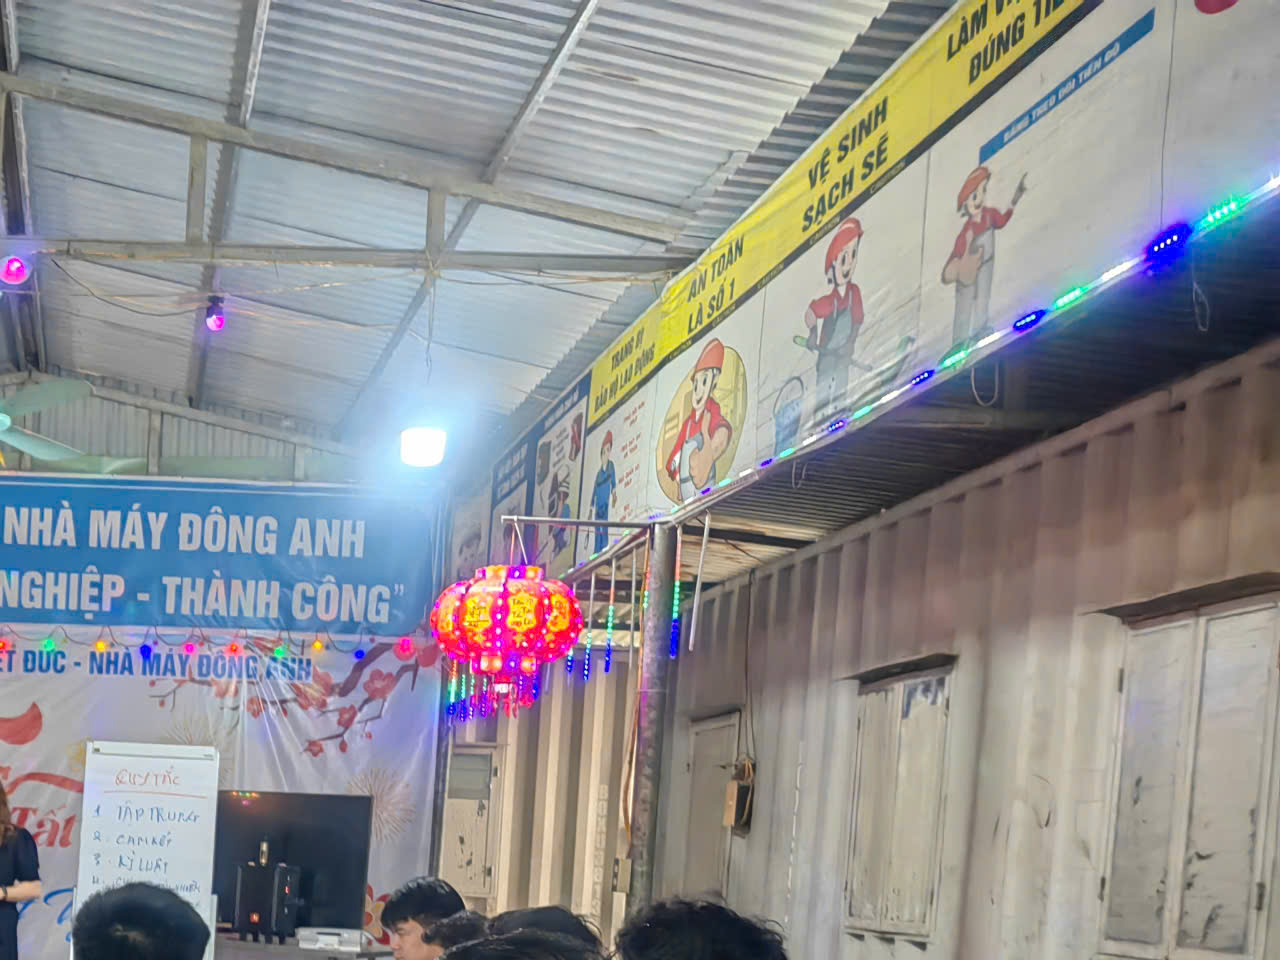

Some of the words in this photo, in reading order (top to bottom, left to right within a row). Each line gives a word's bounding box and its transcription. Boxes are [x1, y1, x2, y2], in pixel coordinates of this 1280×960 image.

[946, 0, 988, 62] LÀM
[968, 12, 1025, 86] ĐÚNG
[808, 147, 830, 189] VỆ
[837, 96, 888, 163] SINH
[802, 166, 855, 232] SẠCH
[861, 131, 888, 180] SẼ
[688, 268, 707, 302] AN
[711, 234, 744, 283] TOÀN
[688, 301, 703, 335] LÀ
[707, 277, 726, 319] SỐ
[729, 277, 735, 300] 1
[3, 500, 77, 547] NHÀ
[88, 502, 169, 550] MÁY
[178, 506, 279, 555] ĐÔNG
[288, 517, 366, 559] ANH
[137, 592, 150, 602] -
[162, 570, 280, 619] THÀNH
[141, 648, 190, 677] MÁY
[197, 651, 259, 679] ĐÔNG
[265, 655, 313, 681] ANH
[150, 806, 200, 823] TRUNG
